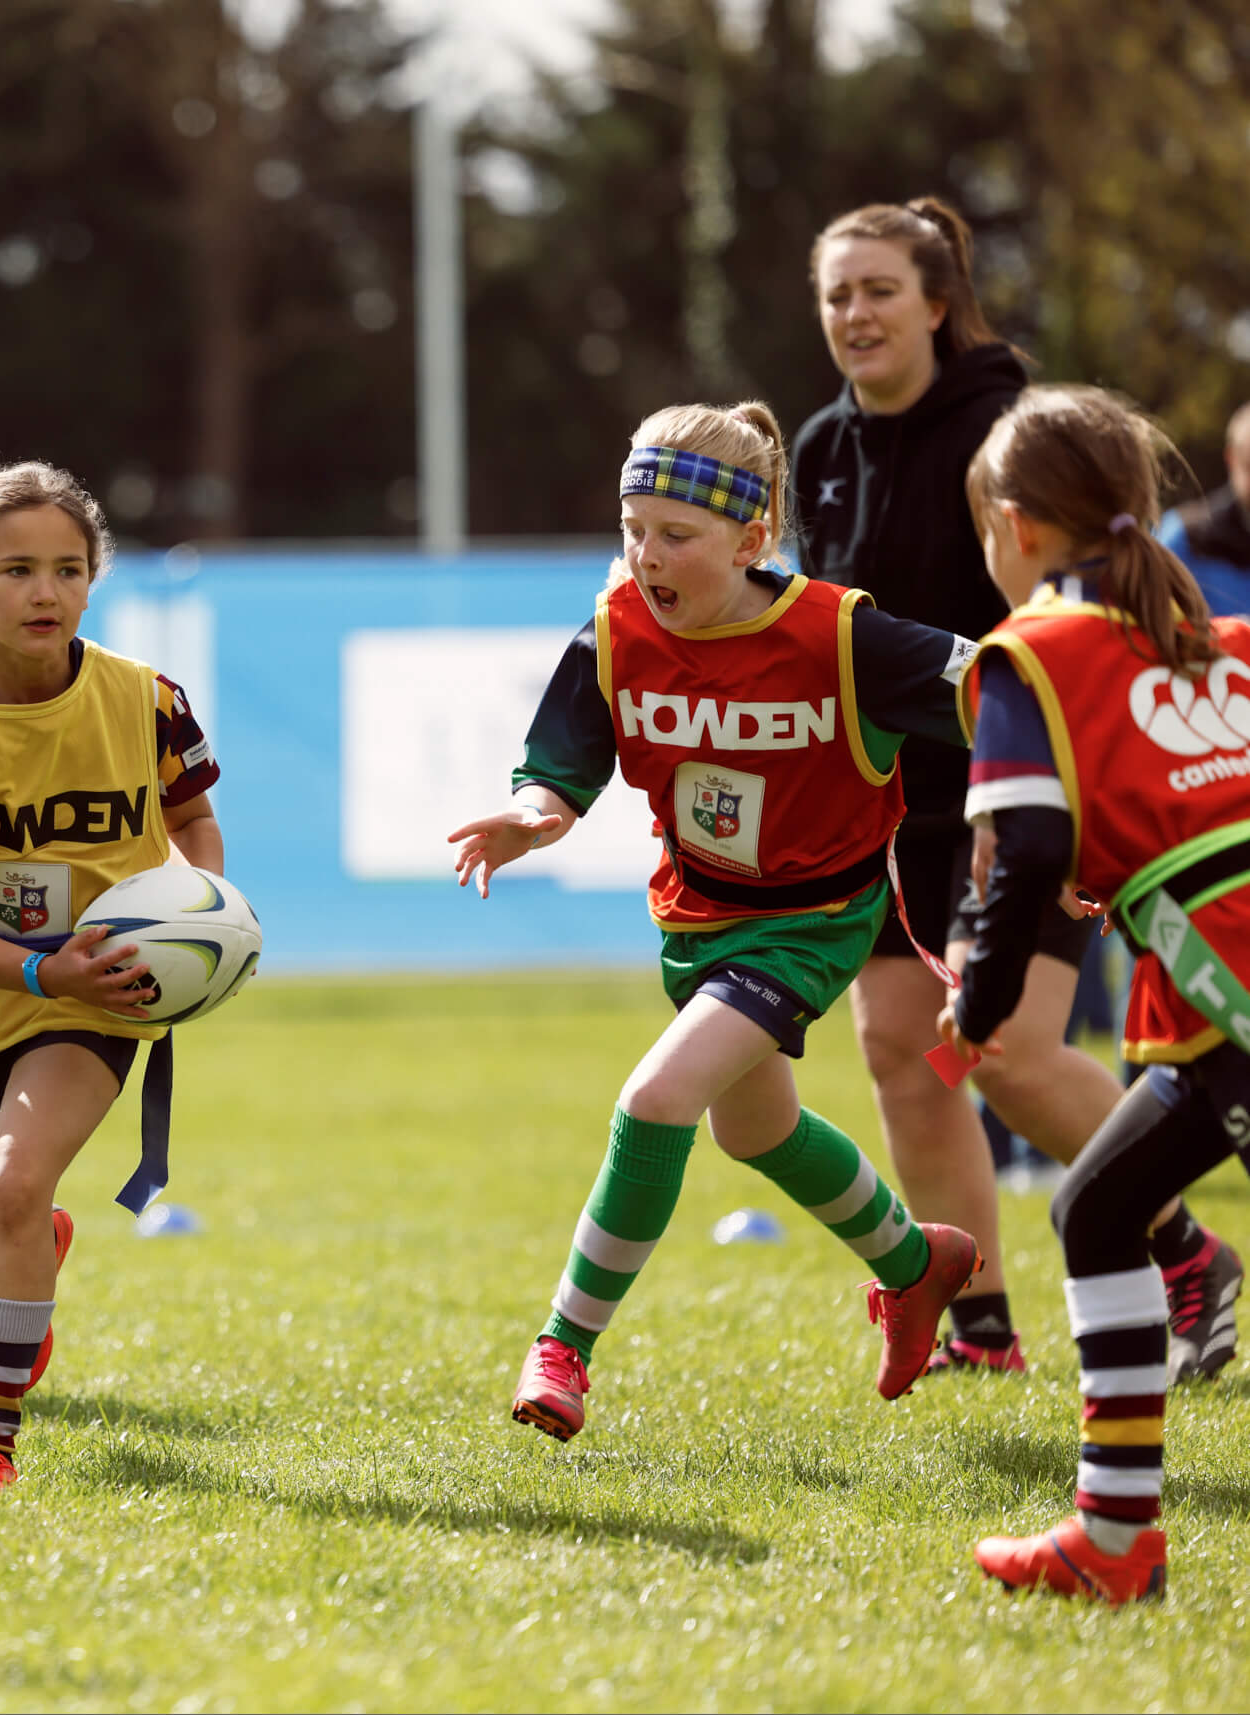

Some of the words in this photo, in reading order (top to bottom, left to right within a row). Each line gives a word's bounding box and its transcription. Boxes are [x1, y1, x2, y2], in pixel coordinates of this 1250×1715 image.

[622, 468, 655, 478] AME'S
[617, 688, 836, 751] HOWDEN
[761, 988, 782, 1007] 2022
